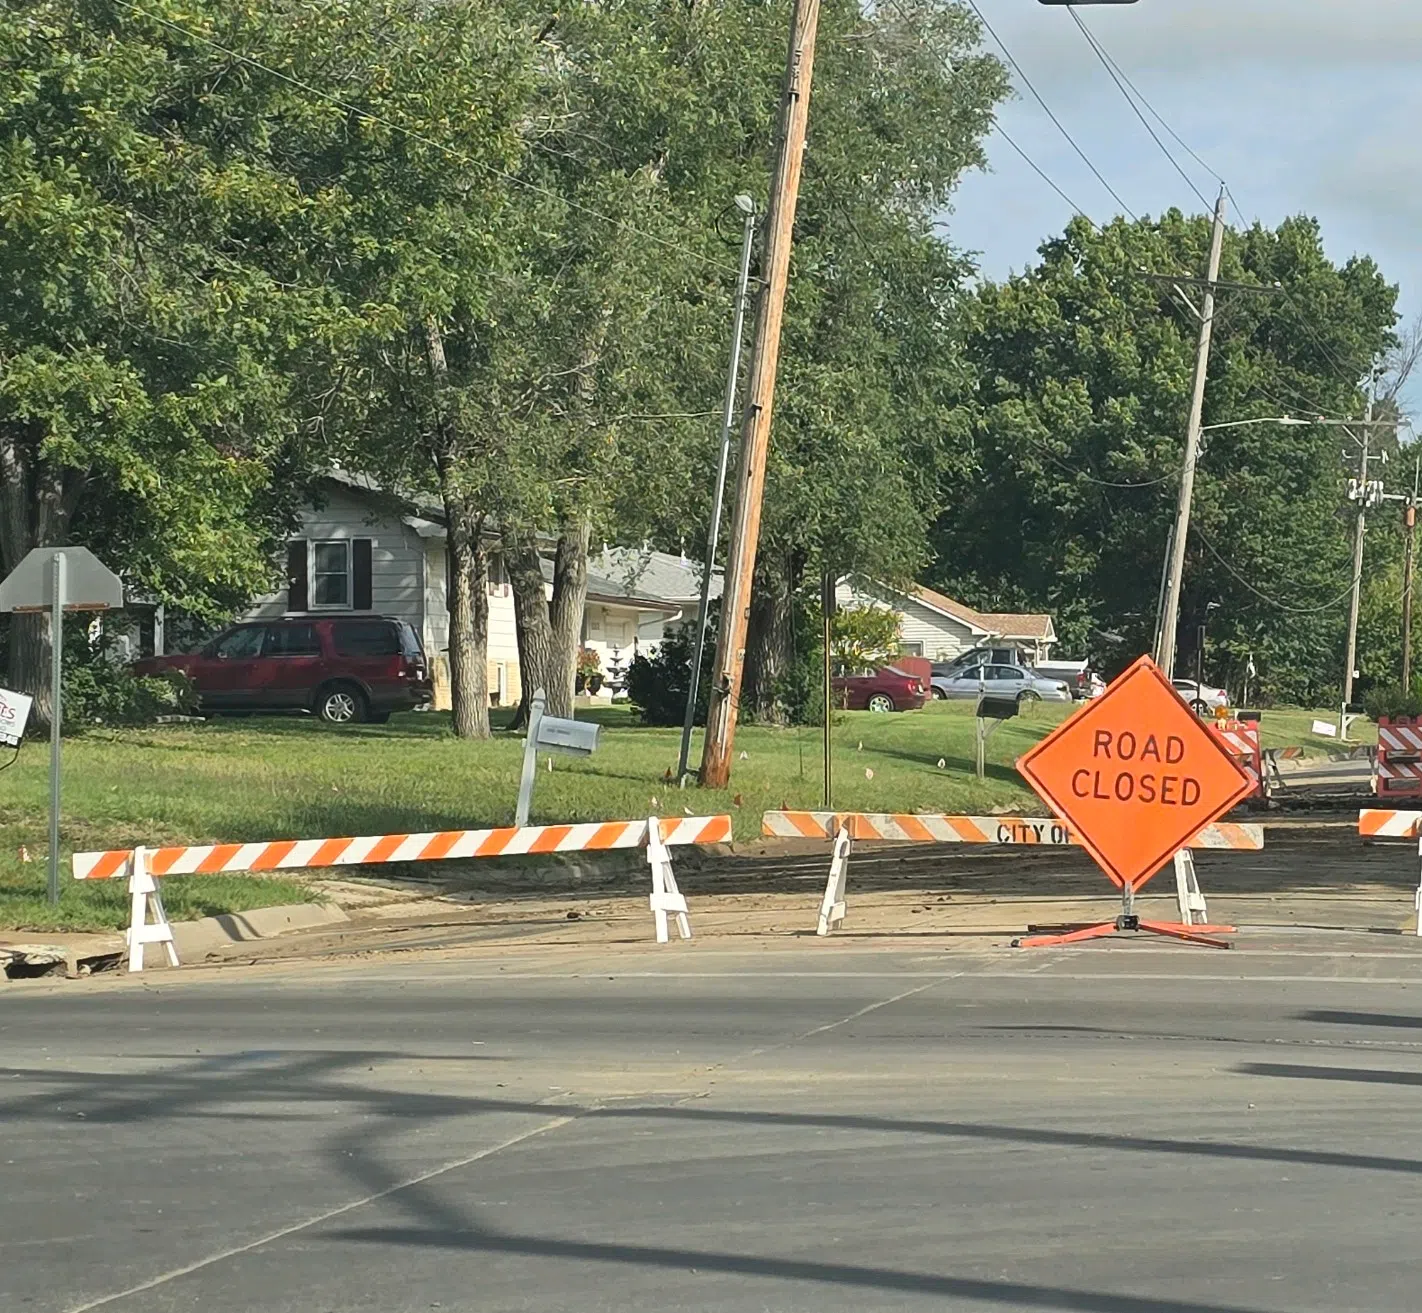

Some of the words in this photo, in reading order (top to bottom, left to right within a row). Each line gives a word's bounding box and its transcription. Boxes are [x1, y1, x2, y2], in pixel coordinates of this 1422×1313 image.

[1093, 730, 1185, 764] ROAD
[1071, 768, 1201, 806] CLOSED
[997, 825, 1044, 843] CITY
